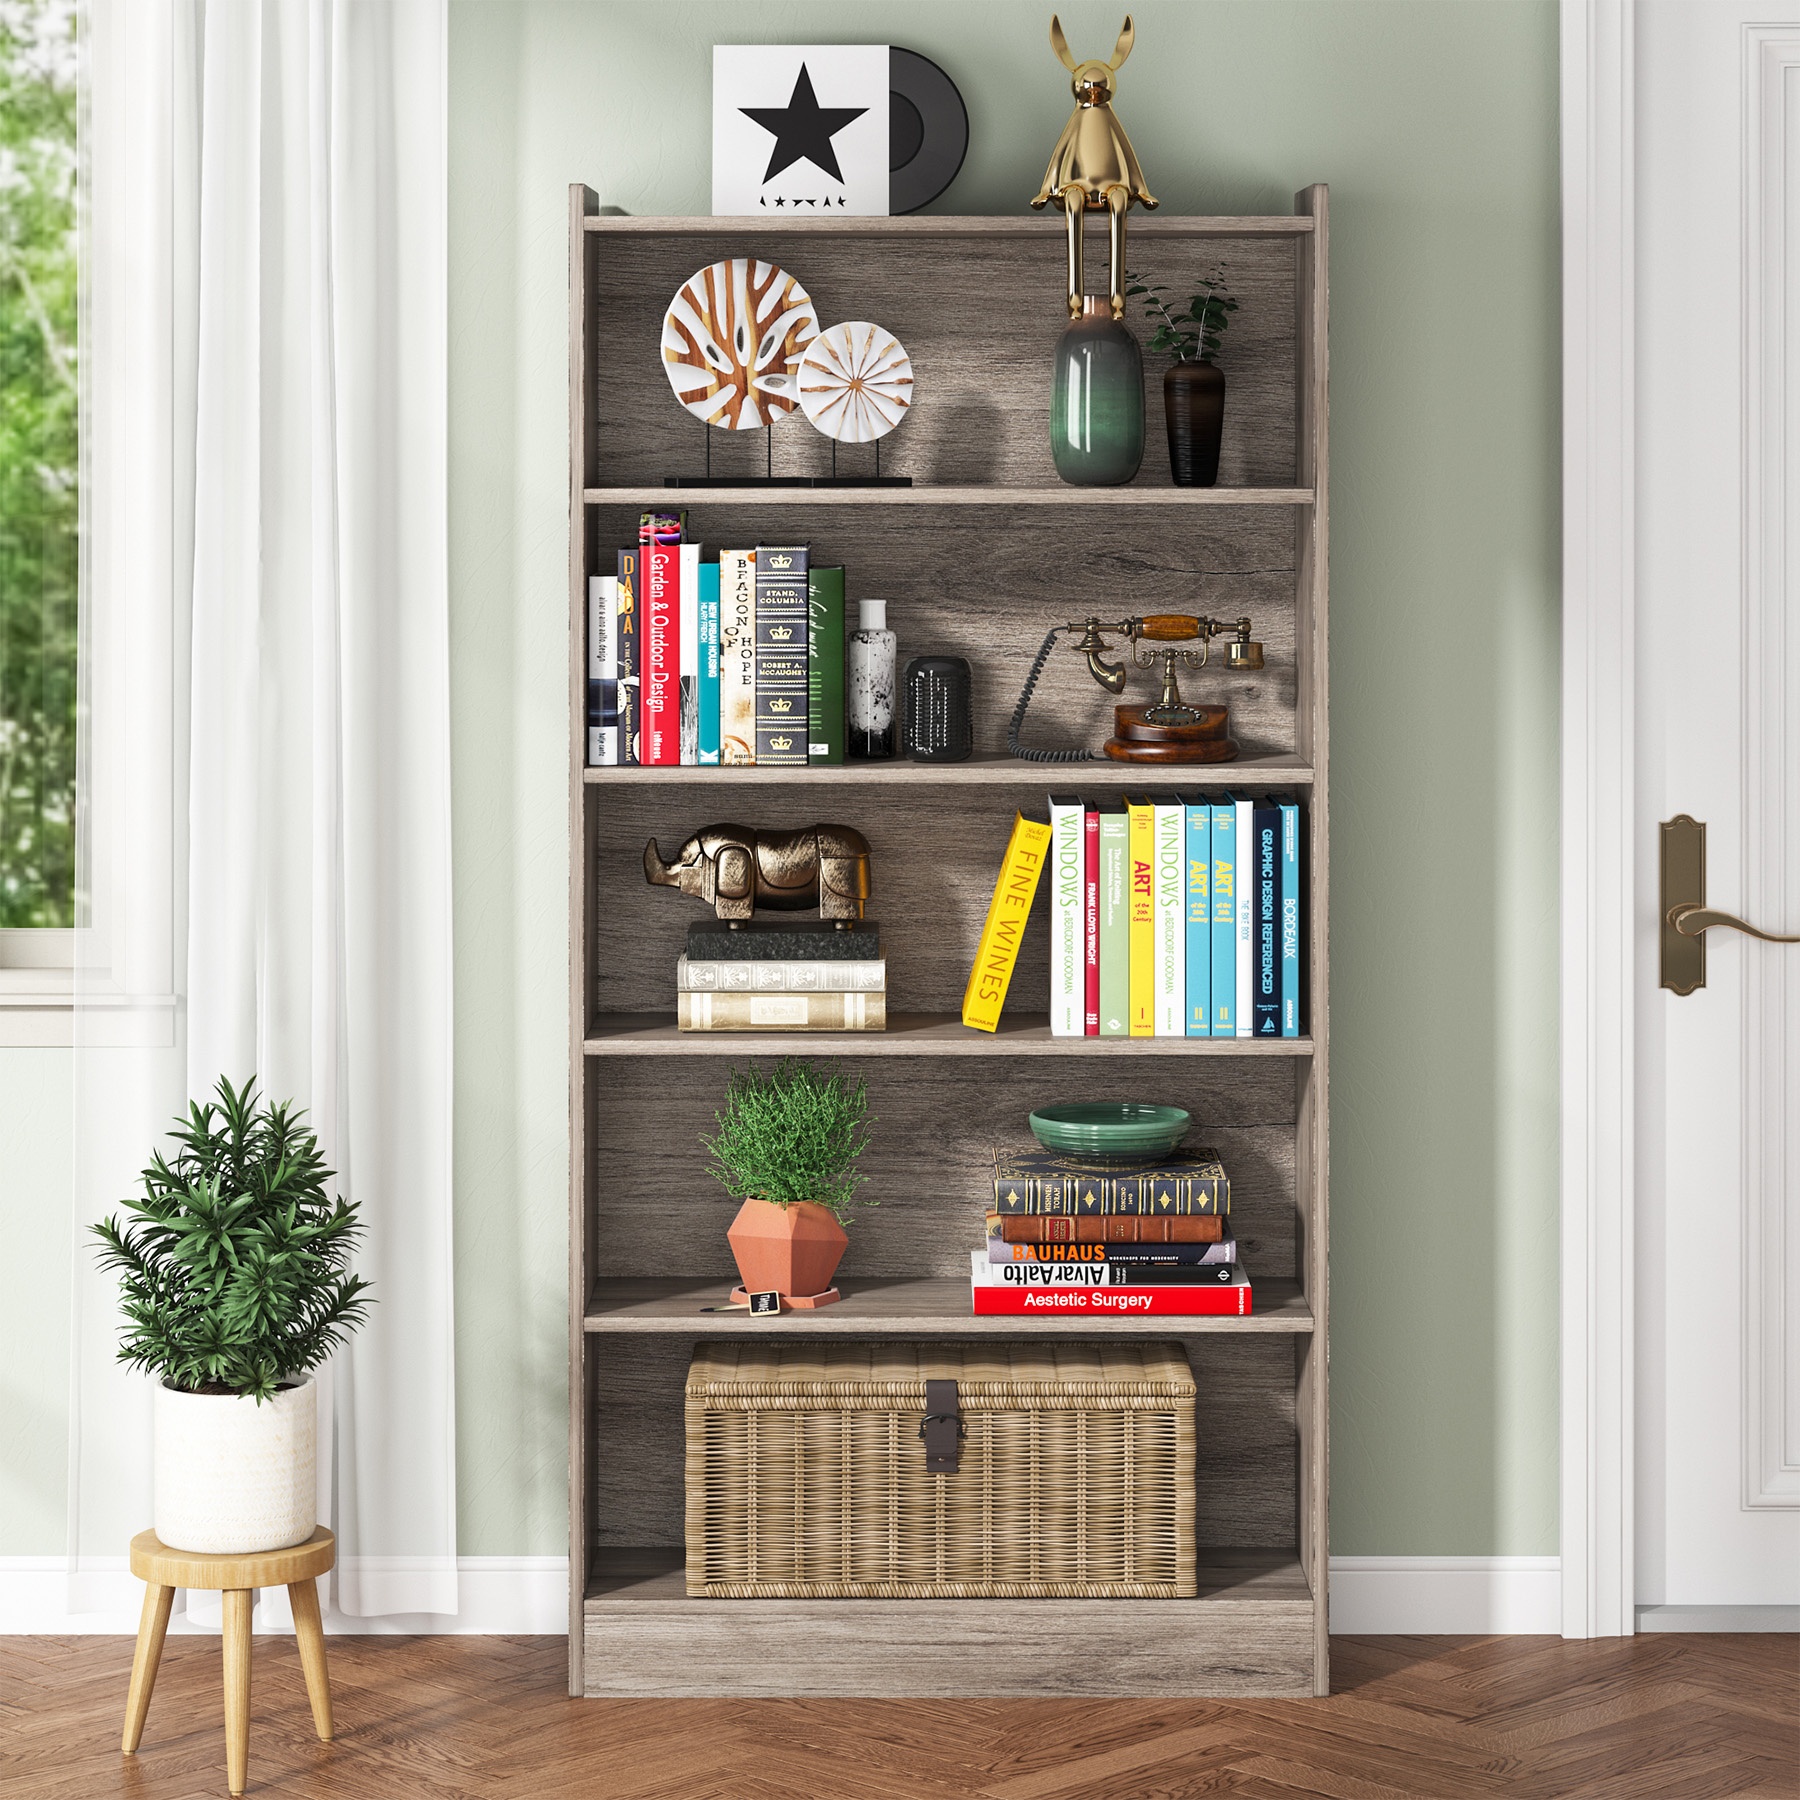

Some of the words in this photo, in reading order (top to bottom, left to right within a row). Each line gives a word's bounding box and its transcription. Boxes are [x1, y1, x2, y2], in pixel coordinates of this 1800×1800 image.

[650, 554, 669, 598] Garden
[624, 556, 634, 634] DADA
[650, 602, 668, 612] &
[699, 602, 707, 620] HILARY
[707, 602, 717, 618] NEW
[650, 615, 669, 668] Outdoor
[699, 621, 707, 643] FRENCH
[707, 620, 717, 644] URBAN
[596, 644, 606, 662] design
[707, 645, 717, 678] HOUSING
[740, 637, 753, 685] HOPE
[645, 672, 668, 713] Design
[1059, 814, 1078, 908] WINDOWS
[1113, 848, 1121, 860] The
[1113, 861, 1121, 872] Art
[1159, 814, 1178, 908] WINDOWS
[1260, 828, 1273, 878] GRAPHIC
[1005, 850, 1038, 908] FINE
[1086, 882, 1095, 908] FRANK
[1134, 860, 1151, 896] ART
[1190, 860, 1208, 897] ART
[1215, 860, 1233, 897] ART
[1260, 880, 1273, 920] DESIGN
[1063, 917, 1073, 954] BERGDORF
[1086, 908, 1095, 933] LLOYD
[1164, 917, 1174, 954] BERGDORF
[1282, 898, 1295, 959] BORDEAUX
[979, 920, 1020, 1002] WINES
[1086, 934, 1095, 965] WRIGHT
[1260, 923, 1273, 994] REFERENCED
[1063, 956, 1073, 994] GOODMAN
[1164, 956, 1174, 994] GOODMAN
[1012, 1244, 1105, 1261] BAUHAUS
[1024, 1292, 1087, 1306] Aestetic
[1091, 1292, 1153, 1310] Surgery
